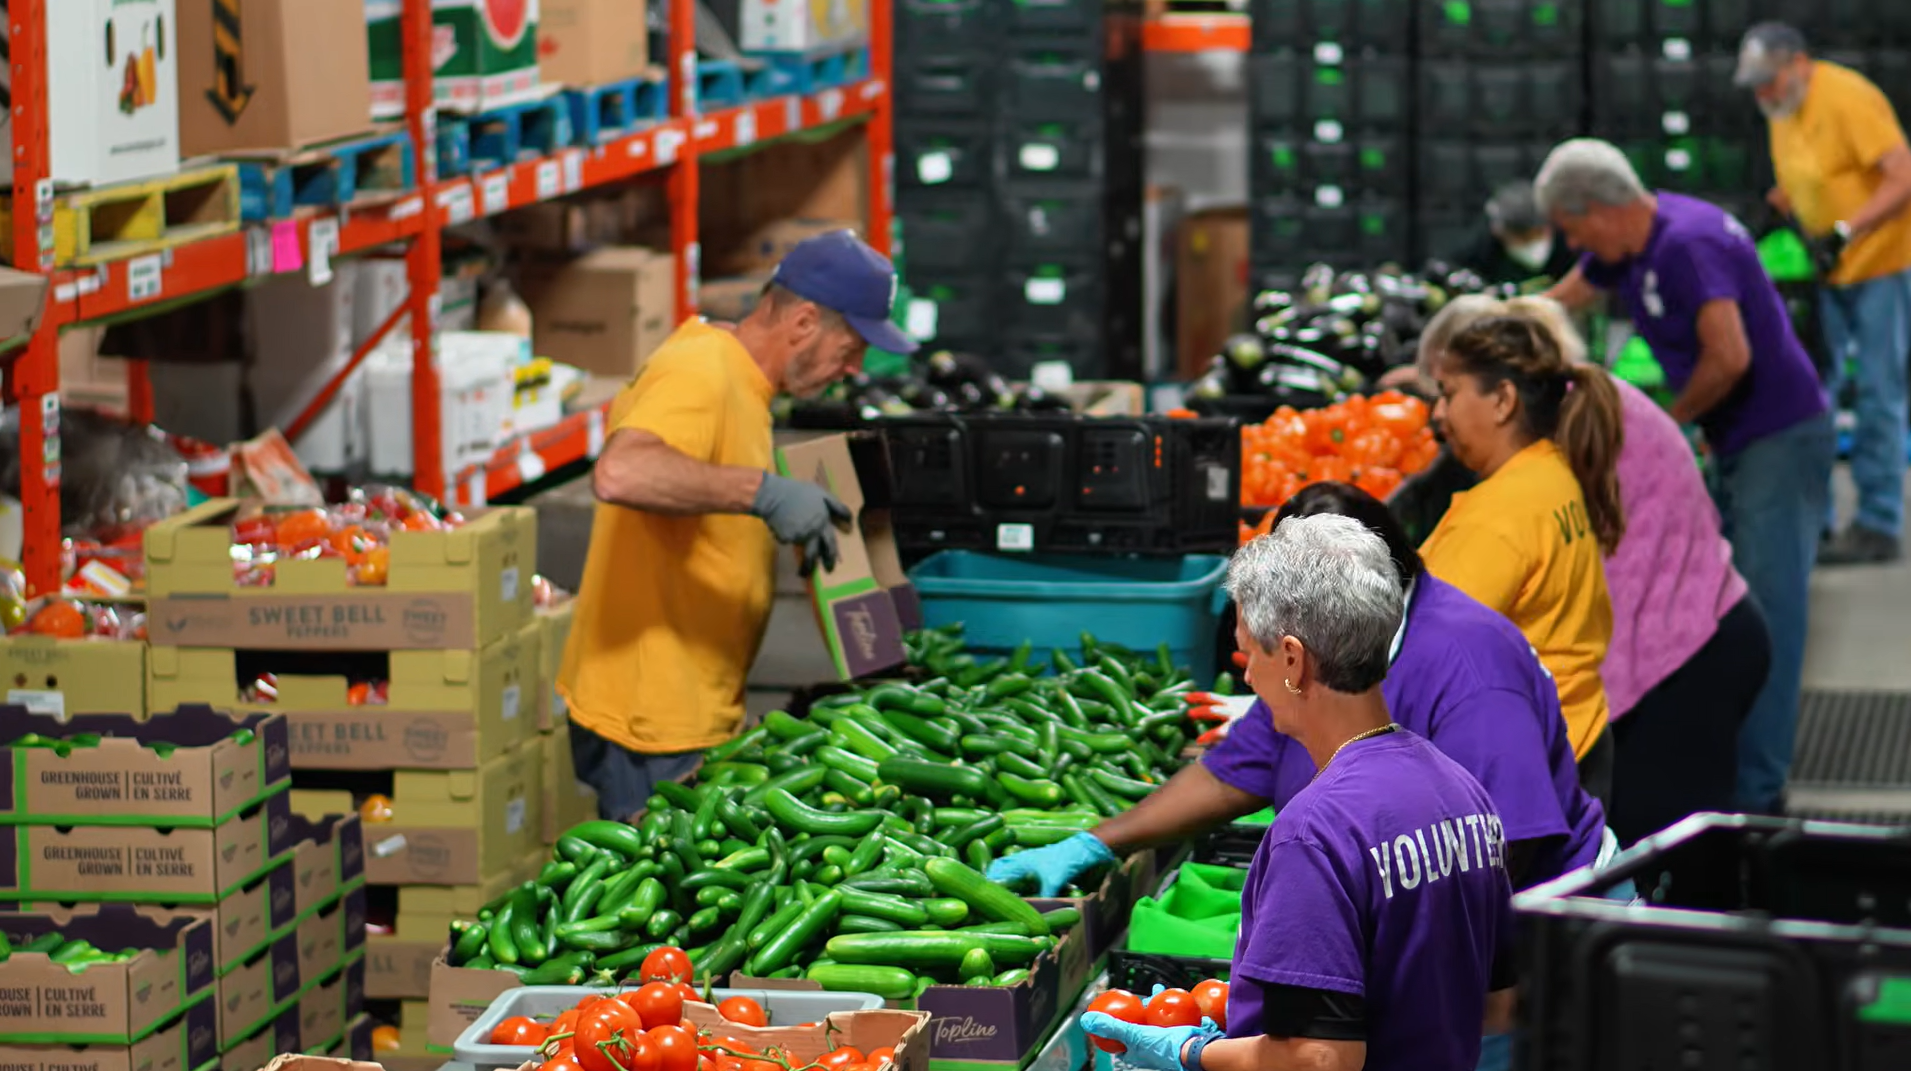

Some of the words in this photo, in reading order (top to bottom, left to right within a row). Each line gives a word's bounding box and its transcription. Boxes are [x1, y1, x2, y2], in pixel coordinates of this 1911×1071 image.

[248, 606, 324, 626] SWEET
[333, 605, 386, 624] BELL
[287, 722, 325, 741] EET
[335, 722, 386, 741] BELL
[41, 770, 120, 784] GREENHOUSE
[133, 770, 182, 785] CULTIVÉ
[75, 786, 121, 800] GROWN
[133, 787, 149, 800] EN
[154, 787, 192, 801] SERRE
[44, 846, 122, 860] GREENHOUSE
[135, 847, 184, 861] CULTIVÉ
[78, 862, 122, 876] GROWN
[136, 863, 152, 876] EN
[156, 863, 194, 876] SERRE
[44, 986, 95, 1002] CULTIVÉ
[45, 1003, 62, 1017] EN
[66, 1003, 106, 1017] SERRE
[930, 1016, 998, 1047] Topline
